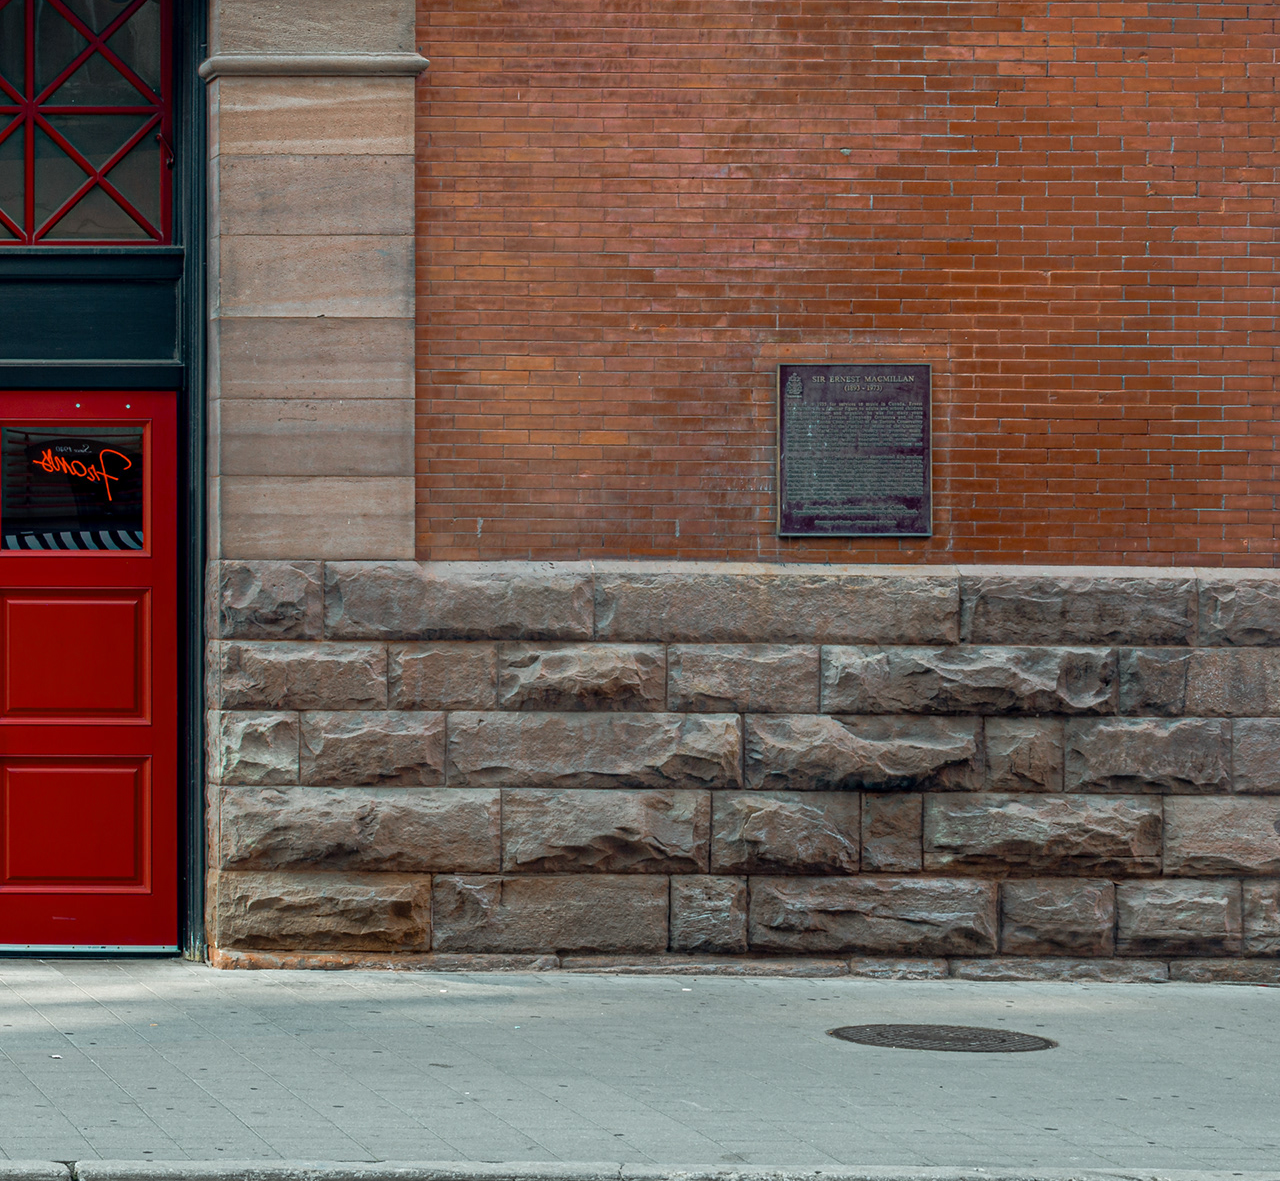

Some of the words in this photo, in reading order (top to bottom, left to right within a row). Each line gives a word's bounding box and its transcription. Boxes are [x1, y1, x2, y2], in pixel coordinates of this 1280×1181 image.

[812, 375, 826, 383] SIR
[829, 375, 861, 383] ERNEST
[864, 375, 915, 383] MACMILLAN
